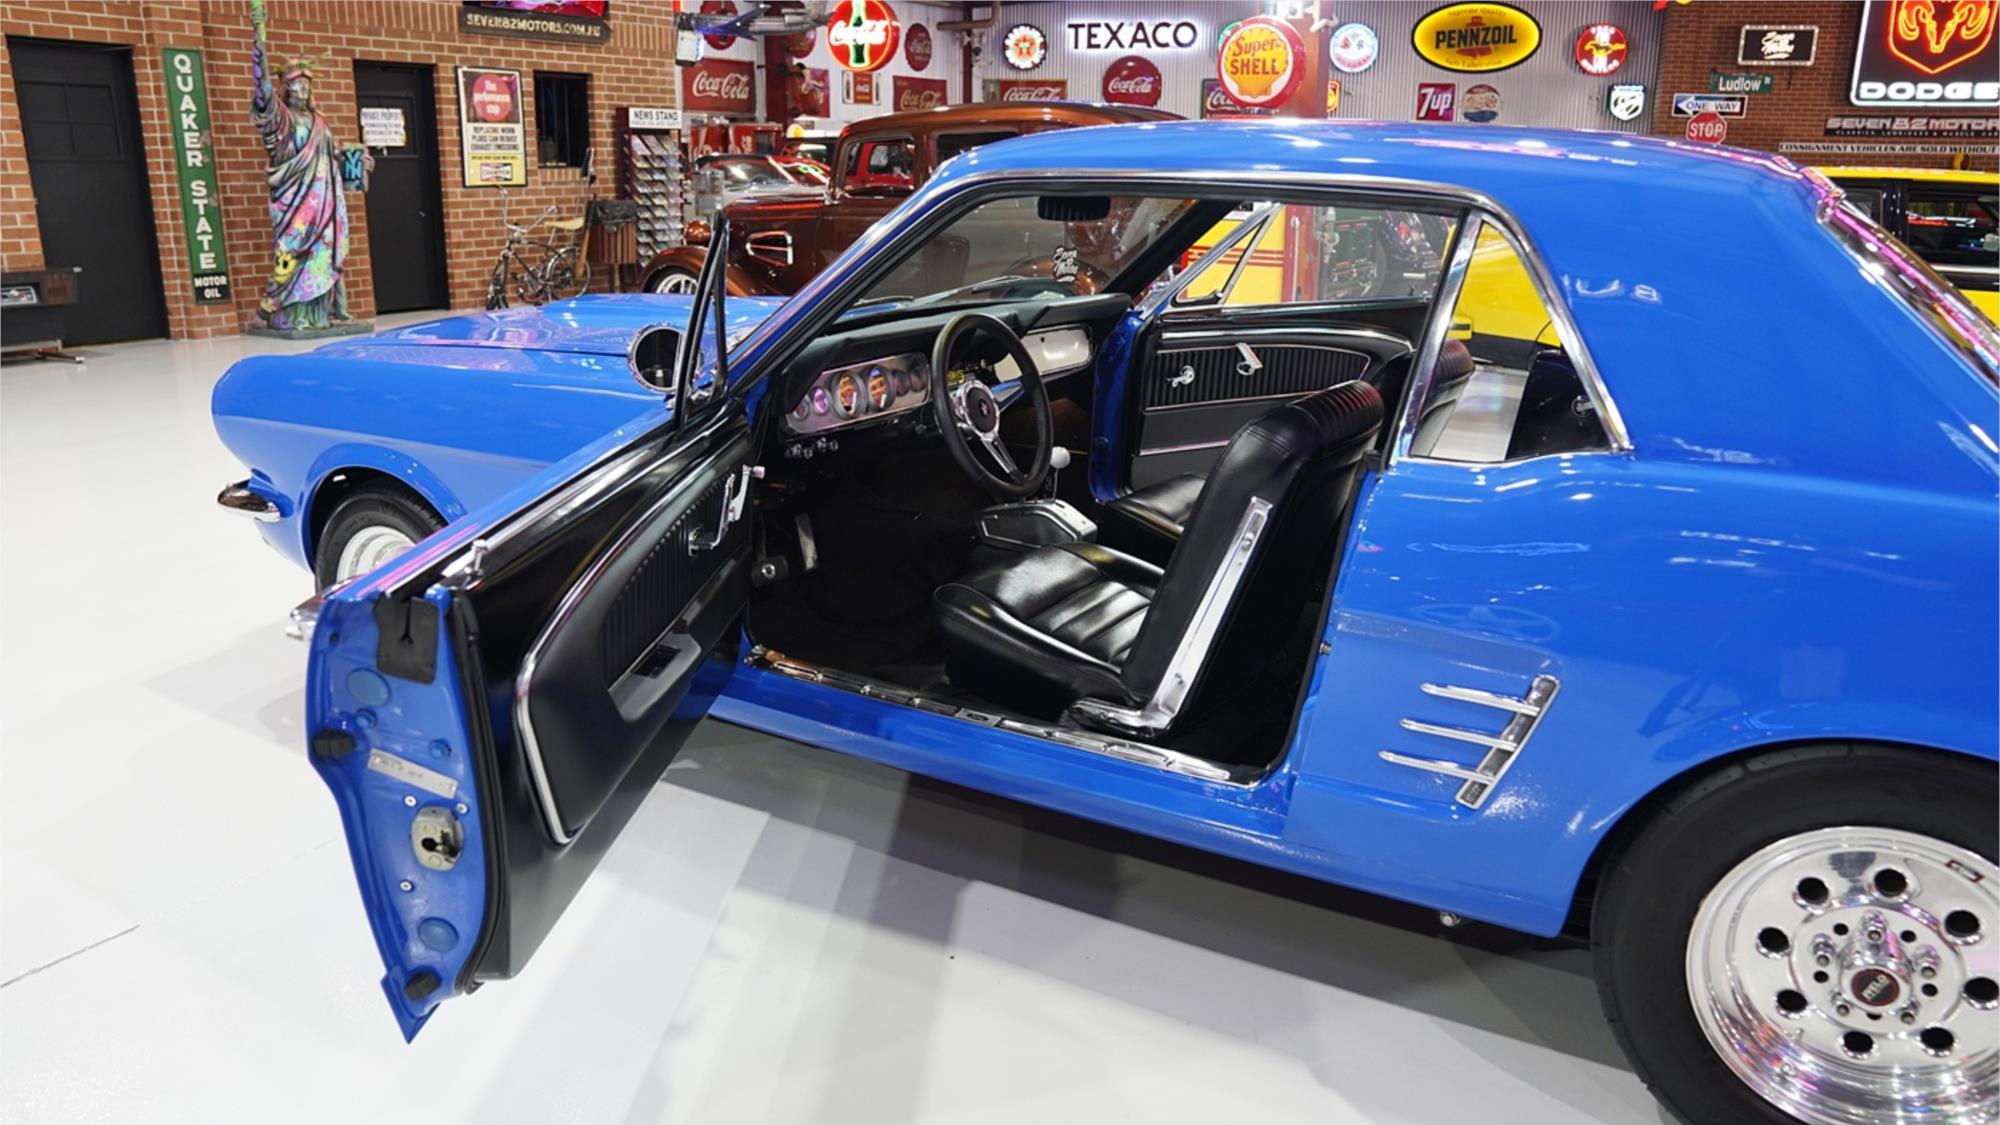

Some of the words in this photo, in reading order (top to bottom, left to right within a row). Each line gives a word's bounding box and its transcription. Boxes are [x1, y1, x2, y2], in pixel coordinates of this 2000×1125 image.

[1067, 21, 1198, 49] TEXACO
[1435, 24, 1518, 50] PENNZOIL
[1230, 58, 1280, 76] SHELL
[692, 70, 750, 99] Coca-Cola
[1108, 76, 1154, 94] Coca-Cola
[1718, 76, 1762, 91] Ludlow
[1859, 81, 2000, 100] DODGE
[1686, 101, 1706, 110] ONE
[1715, 102, 1738, 111] WAY
[633, 110, 654, 121] NEWS
[655, 110, 678, 121] STAND
[1689, 121, 1724, 138] STOP
[1779, 143, 1848, 152] CONSIGNMENT
[1849, 144, 1897, 153] VEHICLES
[1898, 145, 1918, 153] ARE
[1920, 145, 1947, 153] SOLD
[1948, 145, 1996, 153] WITHOUT
[173, 53, 204, 168] QUAKER
[190, 180, 217, 270] STATE
[194, 276, 228, 288] MOTOR
[204, 288, 222, 299] OIL
